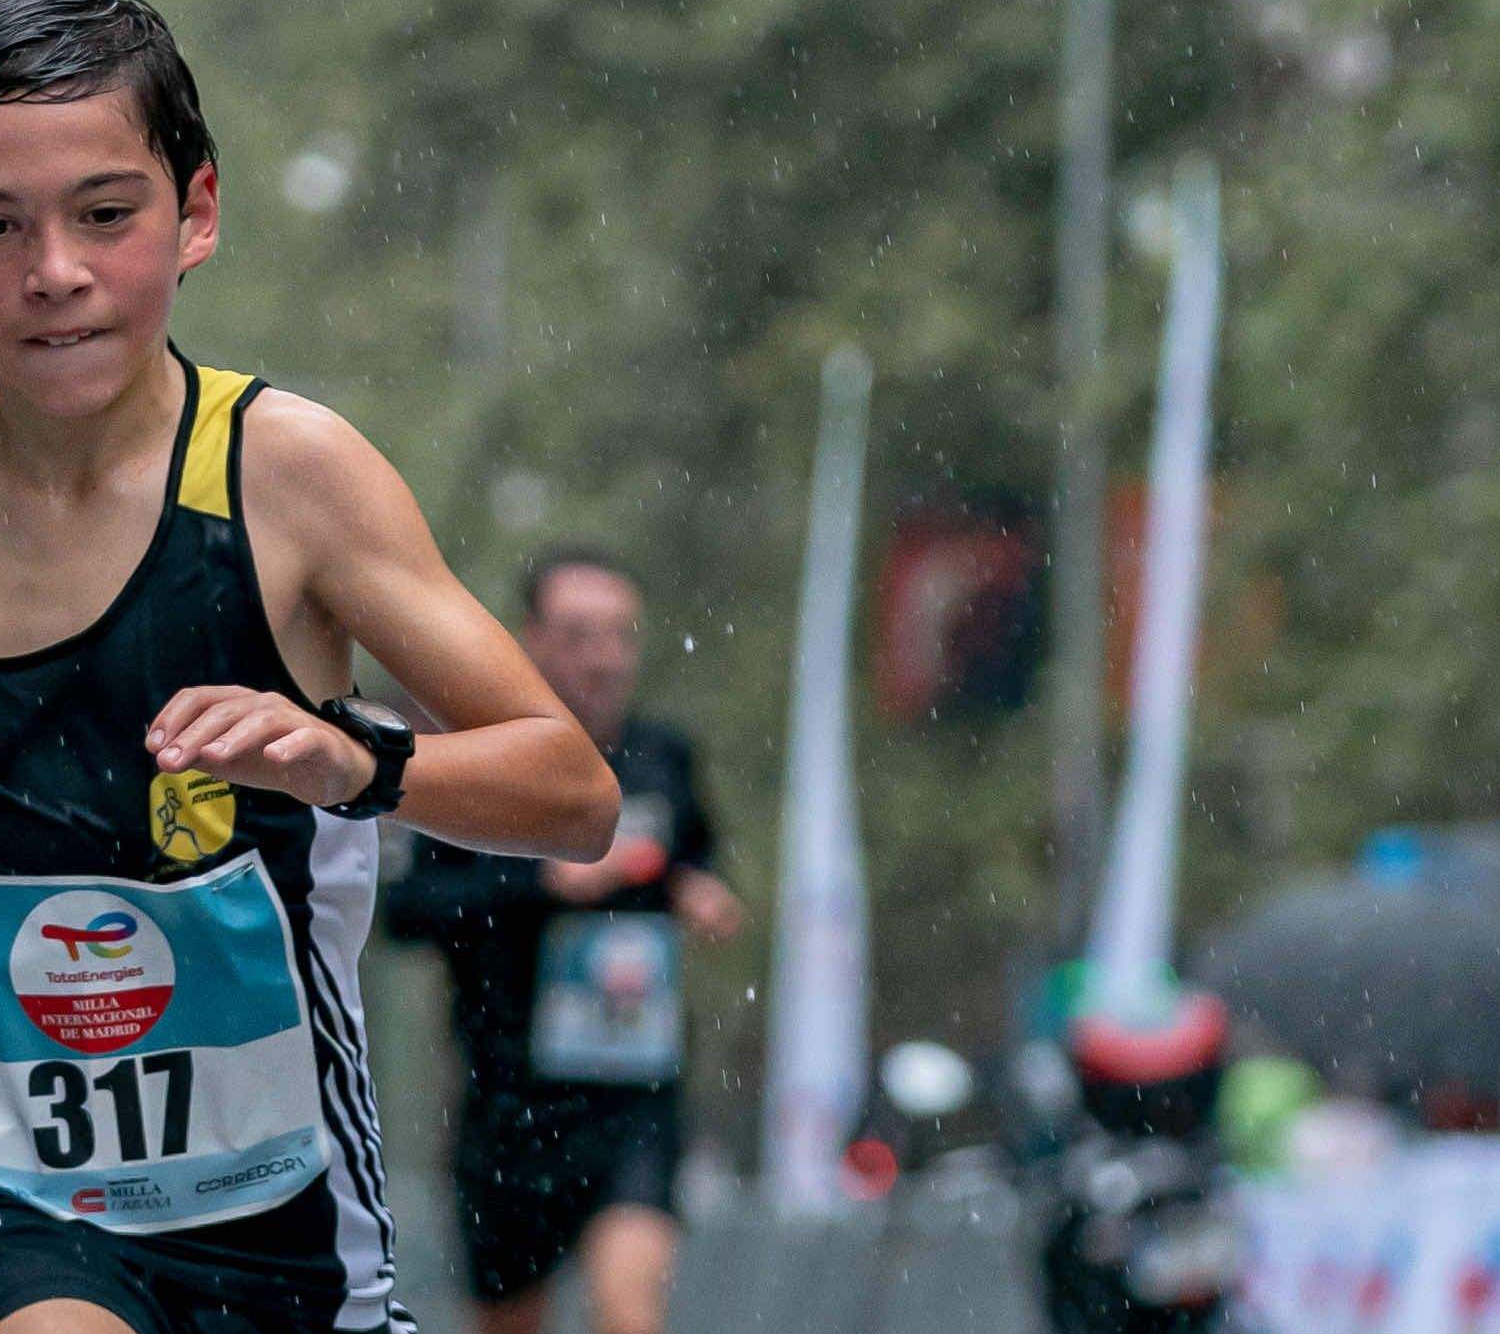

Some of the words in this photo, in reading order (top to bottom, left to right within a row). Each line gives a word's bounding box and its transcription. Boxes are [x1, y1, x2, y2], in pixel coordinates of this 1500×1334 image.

[45, 966, 144, 983] TotalEnergies
[72, 996, 120, 1011] MILLA
[41, 1006, 157, 1025] INTERNACIONAL
[60, 1028, 79, 1040] DE
[81, 1022, 141, 1039] MADRID
[29, 1050, 195, 1169] 317
